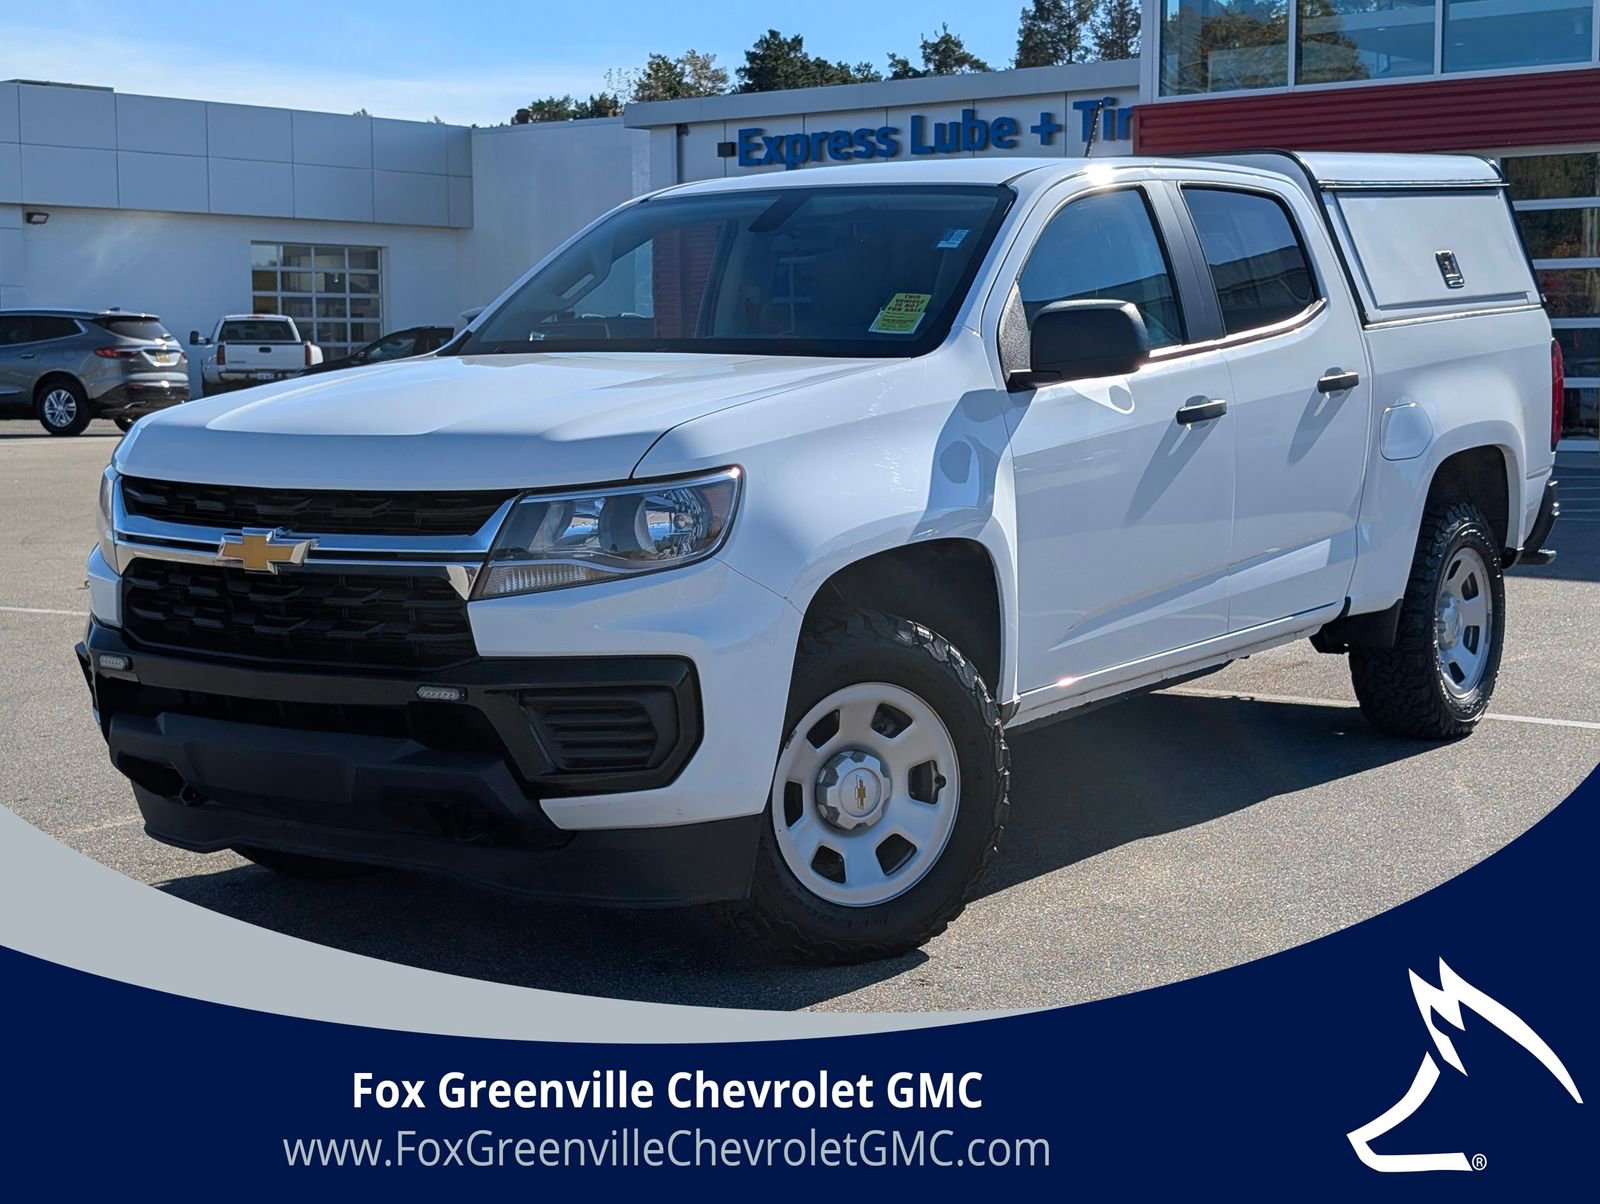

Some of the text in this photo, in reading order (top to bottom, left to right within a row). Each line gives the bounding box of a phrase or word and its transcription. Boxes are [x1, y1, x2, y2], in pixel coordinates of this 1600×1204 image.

[738, 127, 900, 170] Express
[911, 109, 1018, 154] Lube
[1031, 112, 1063, 146] +
